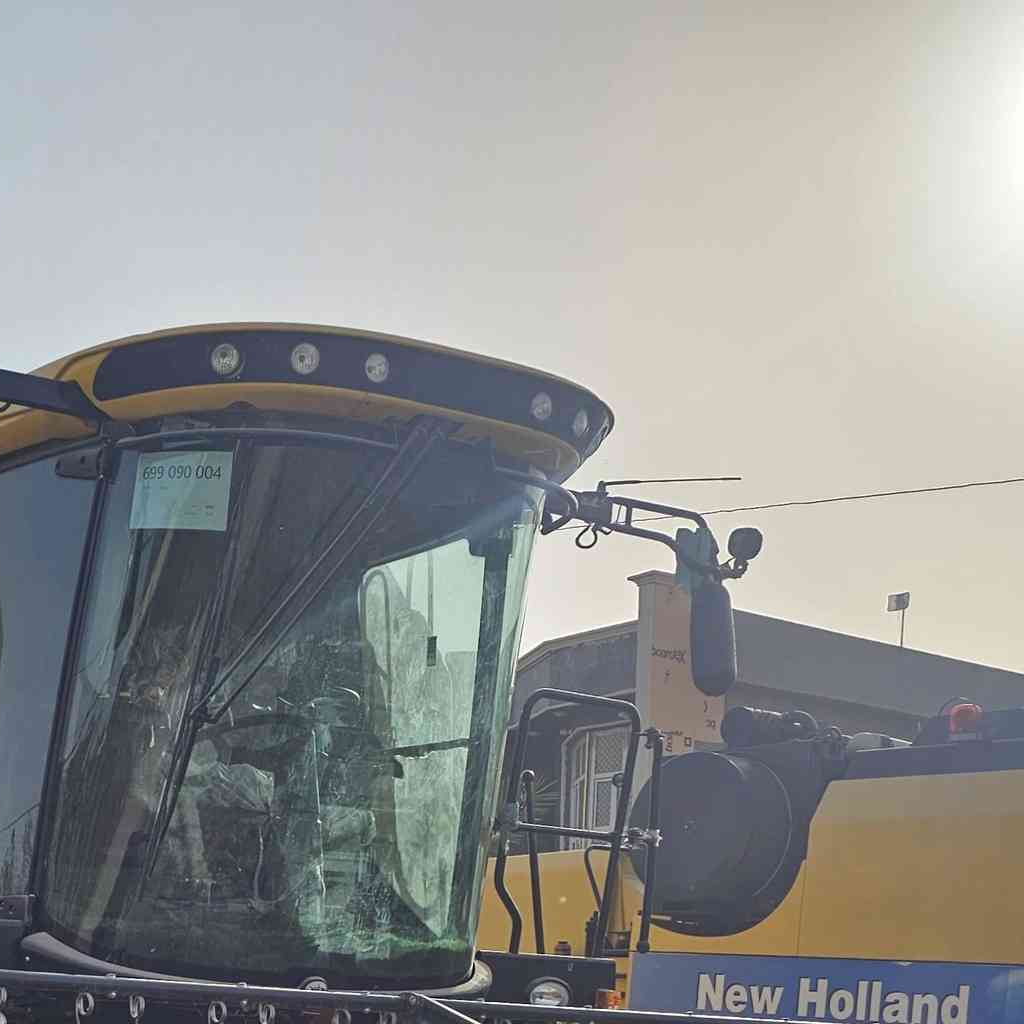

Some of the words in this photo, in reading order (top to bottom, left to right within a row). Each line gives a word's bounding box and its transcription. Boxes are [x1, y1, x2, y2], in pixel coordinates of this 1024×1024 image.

[143, 465, 164, 480] 699
[168, 465, 192, 479] 090
[196, 465, 222, 480] 004
[696, 972, 785, 1016] New
